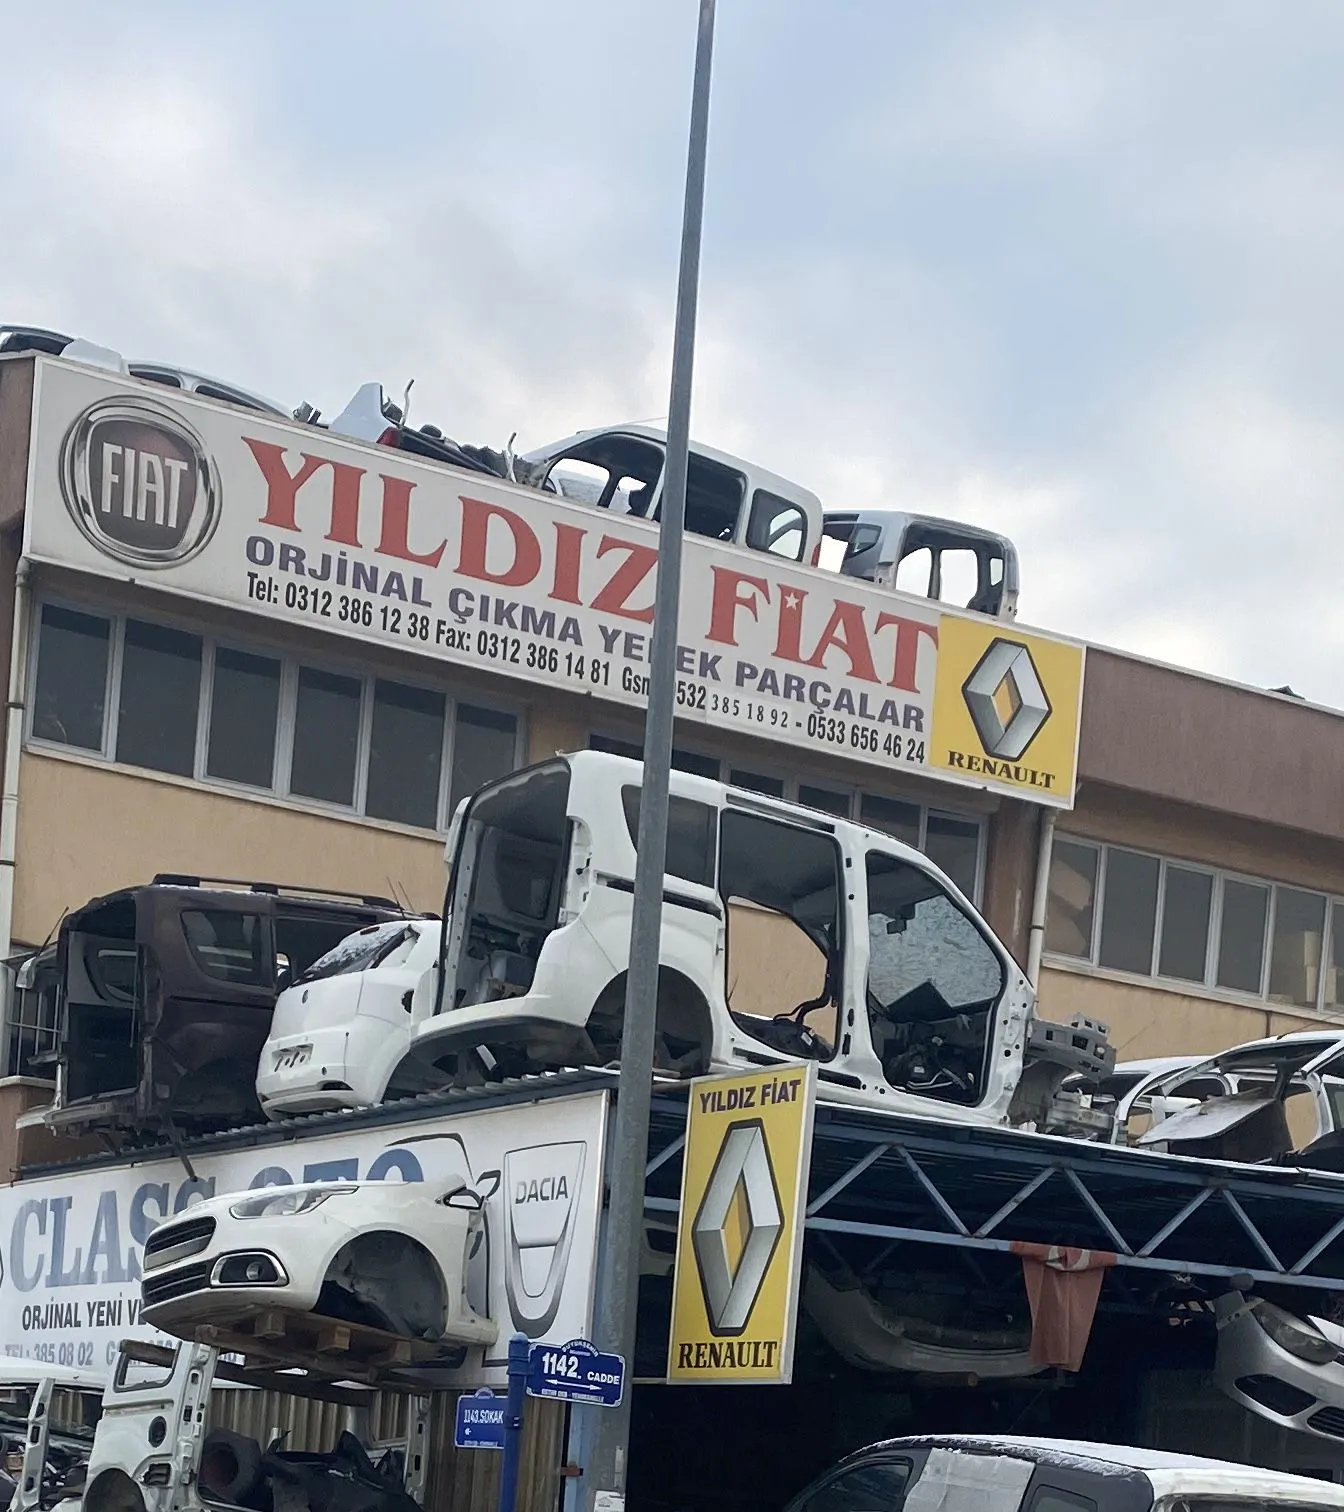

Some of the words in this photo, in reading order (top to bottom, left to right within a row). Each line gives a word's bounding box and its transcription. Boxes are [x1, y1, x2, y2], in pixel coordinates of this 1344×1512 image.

[101, 443, 189, 528] FIAT
[241, 436, 659, 624] YILDIZ
[245, 535, 432, 608] ORJİNAL
[449, 587, 583, 647] ÇIKMA
[599, 624, 723, 681] YEEK
[735, 661, 925, 732] PARÇALAR
[246, 571, 279, 603] Tel:
[285, 581, 333, 617] 0312
[339, 596, 373, 627] 386
[380, 606, 402, 634] 12
[408, 612, 430, 641] 38
[435, 620, 471, 652] Fax:
[477, 630, 520, 663] 0312
[526, 643, 558, 673] 386
[565, 652, 586, 680] 14
[591, 659, 610, 686] 81
[676, 680, 706, 710] 532
[711, 693, 740, 717] 385
[746, 700, 764, 722] 18
[770, 706, 788, 728] 92
[807, 713, 845, 744] 0533
[850, 723, 879, 753] 656
[883, 732, 903, 760] 46
[906, 737, 925, 763] 24
[948, 750, 1056, 788] RENAULT
[699, 1084, 757, 1114] YILDIZ
[760, 1076, 801, 1106] FİAT
[515, 1174, 569, 1205] DACIA
[22, 1296, 82, 1331] ORJİNAL
[87, 1292, 123, 1327] YENİ
[58, 1341, 74, 1366] 08
[77, 1341, 94, 1366] 02
[542, 1352, 582, 1379] 1142.
[587, 1371, 620, 1385] CADDE
[678, 1340, 778, 1368] RENAULT
